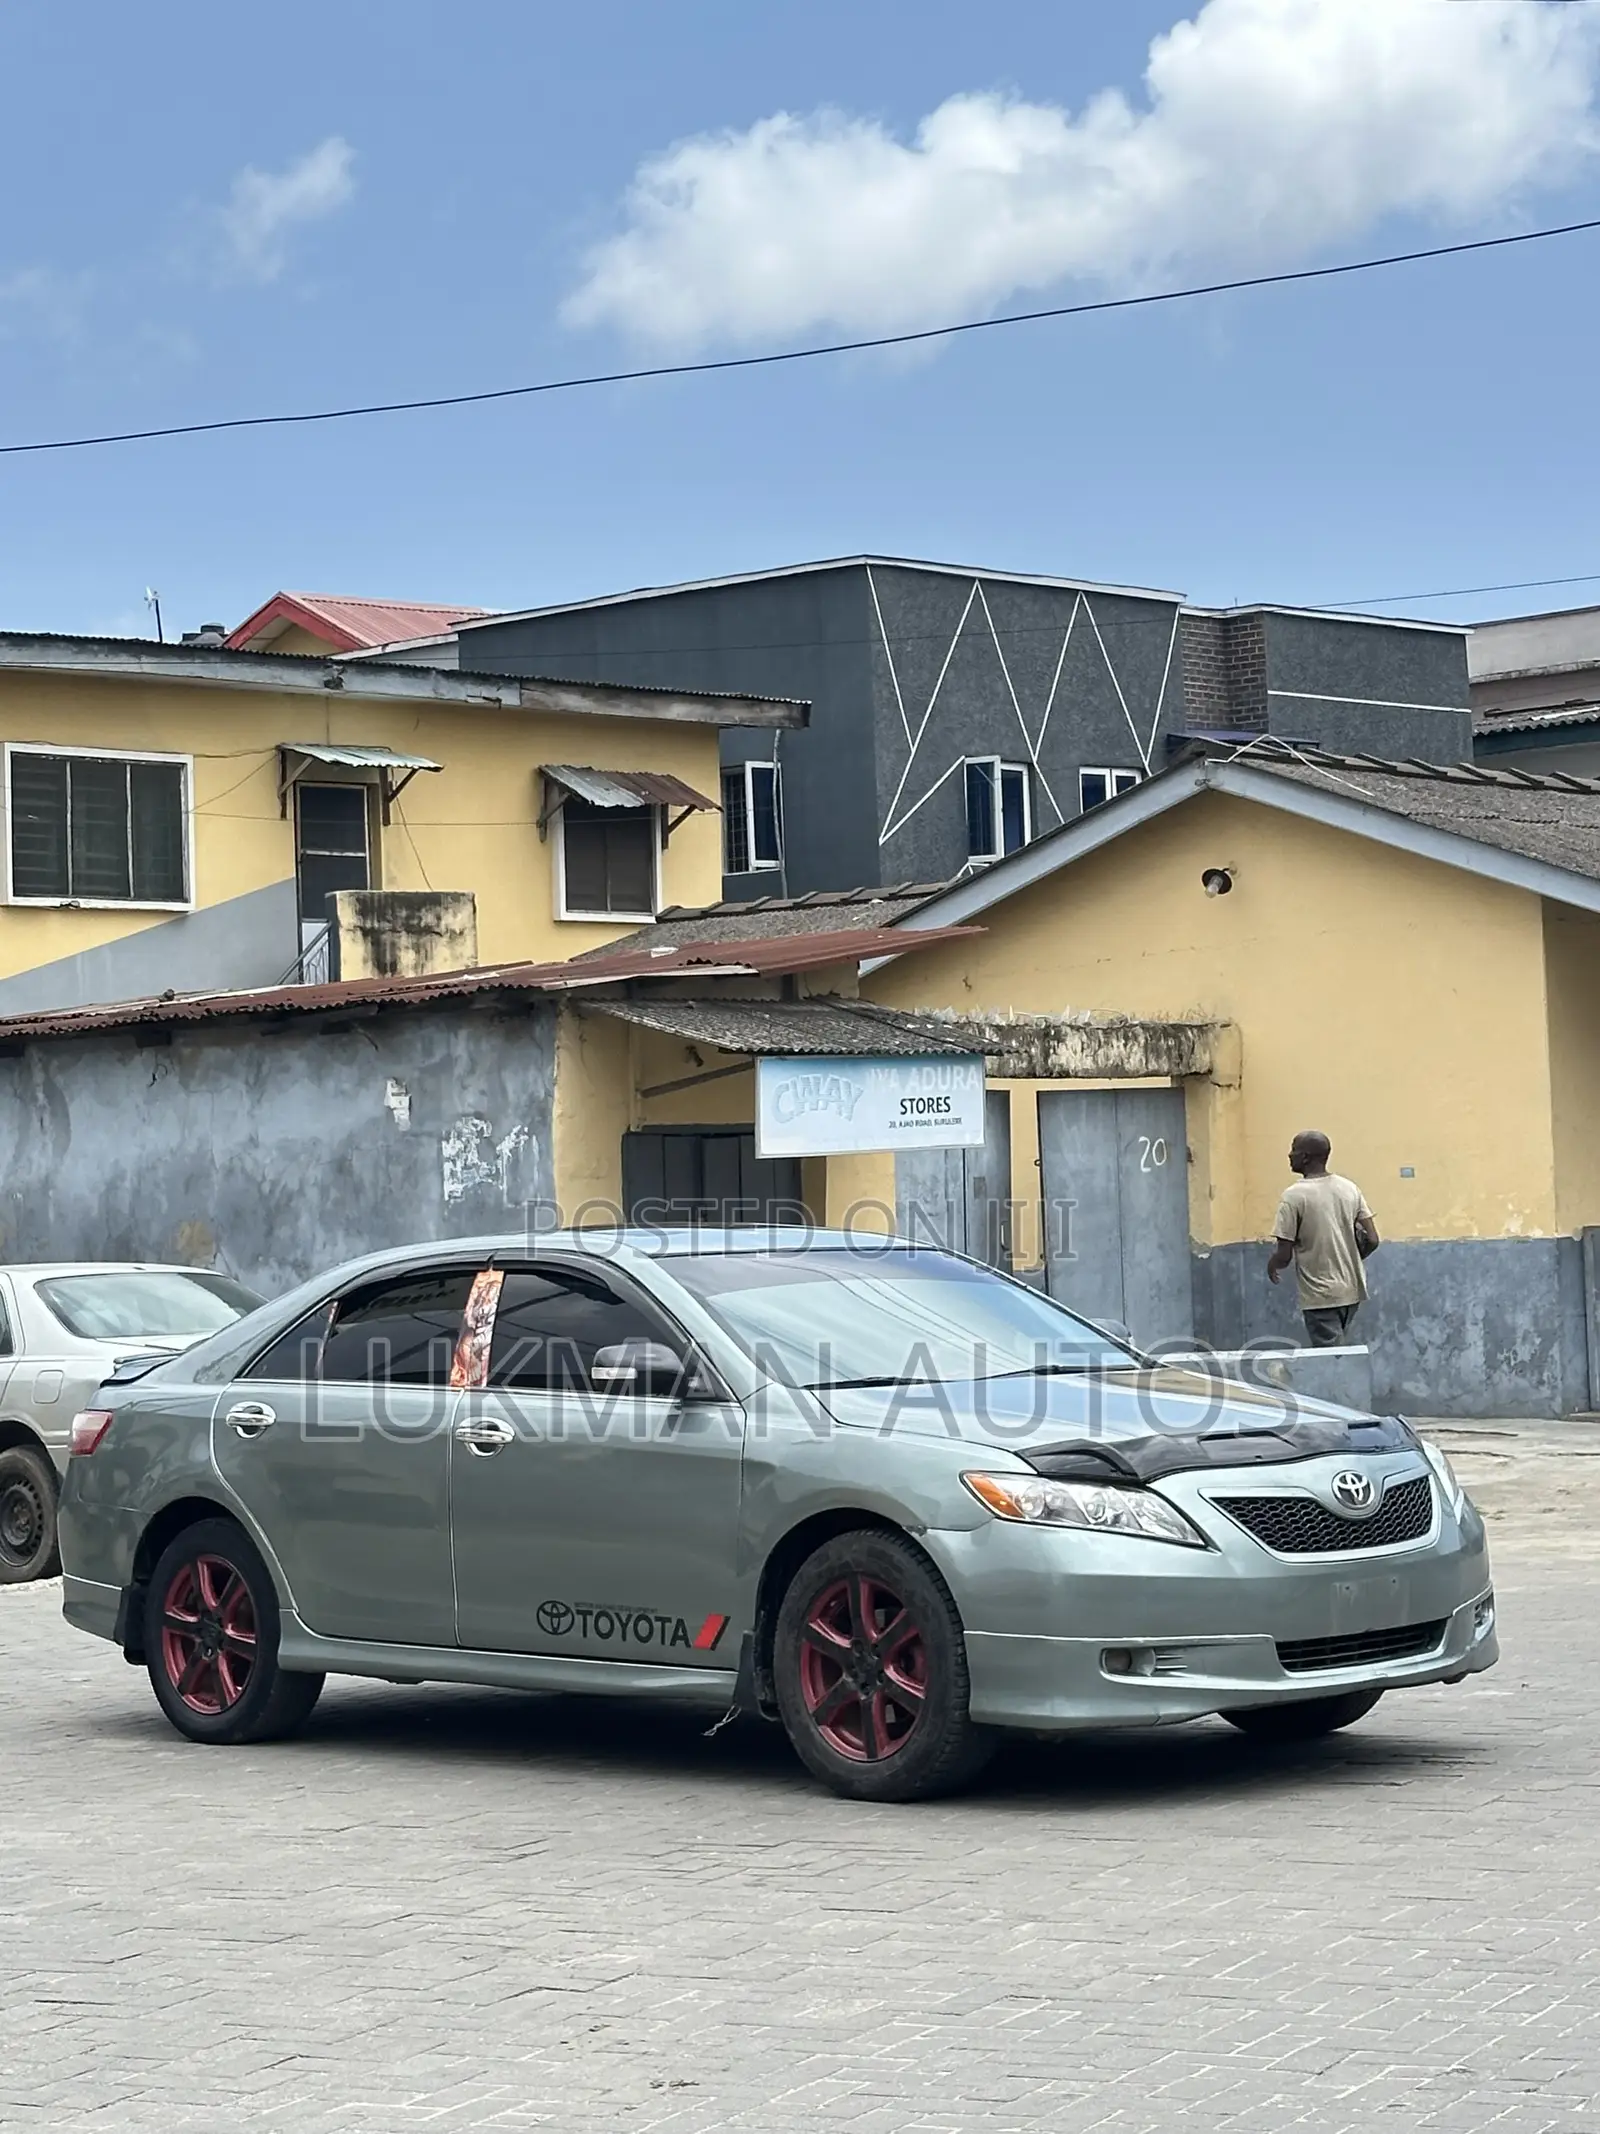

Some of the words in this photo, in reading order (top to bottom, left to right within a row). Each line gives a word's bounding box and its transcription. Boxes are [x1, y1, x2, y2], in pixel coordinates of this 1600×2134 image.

[905, 1064, 979, 1093] ADURA
[772, 1073, 864, 1124] CWAY
[900, 1096, 951, 1115] STORES
[1138, 1135, 1168, 1174] 20
[576, 1608, 692, 1648] TOYOTA
